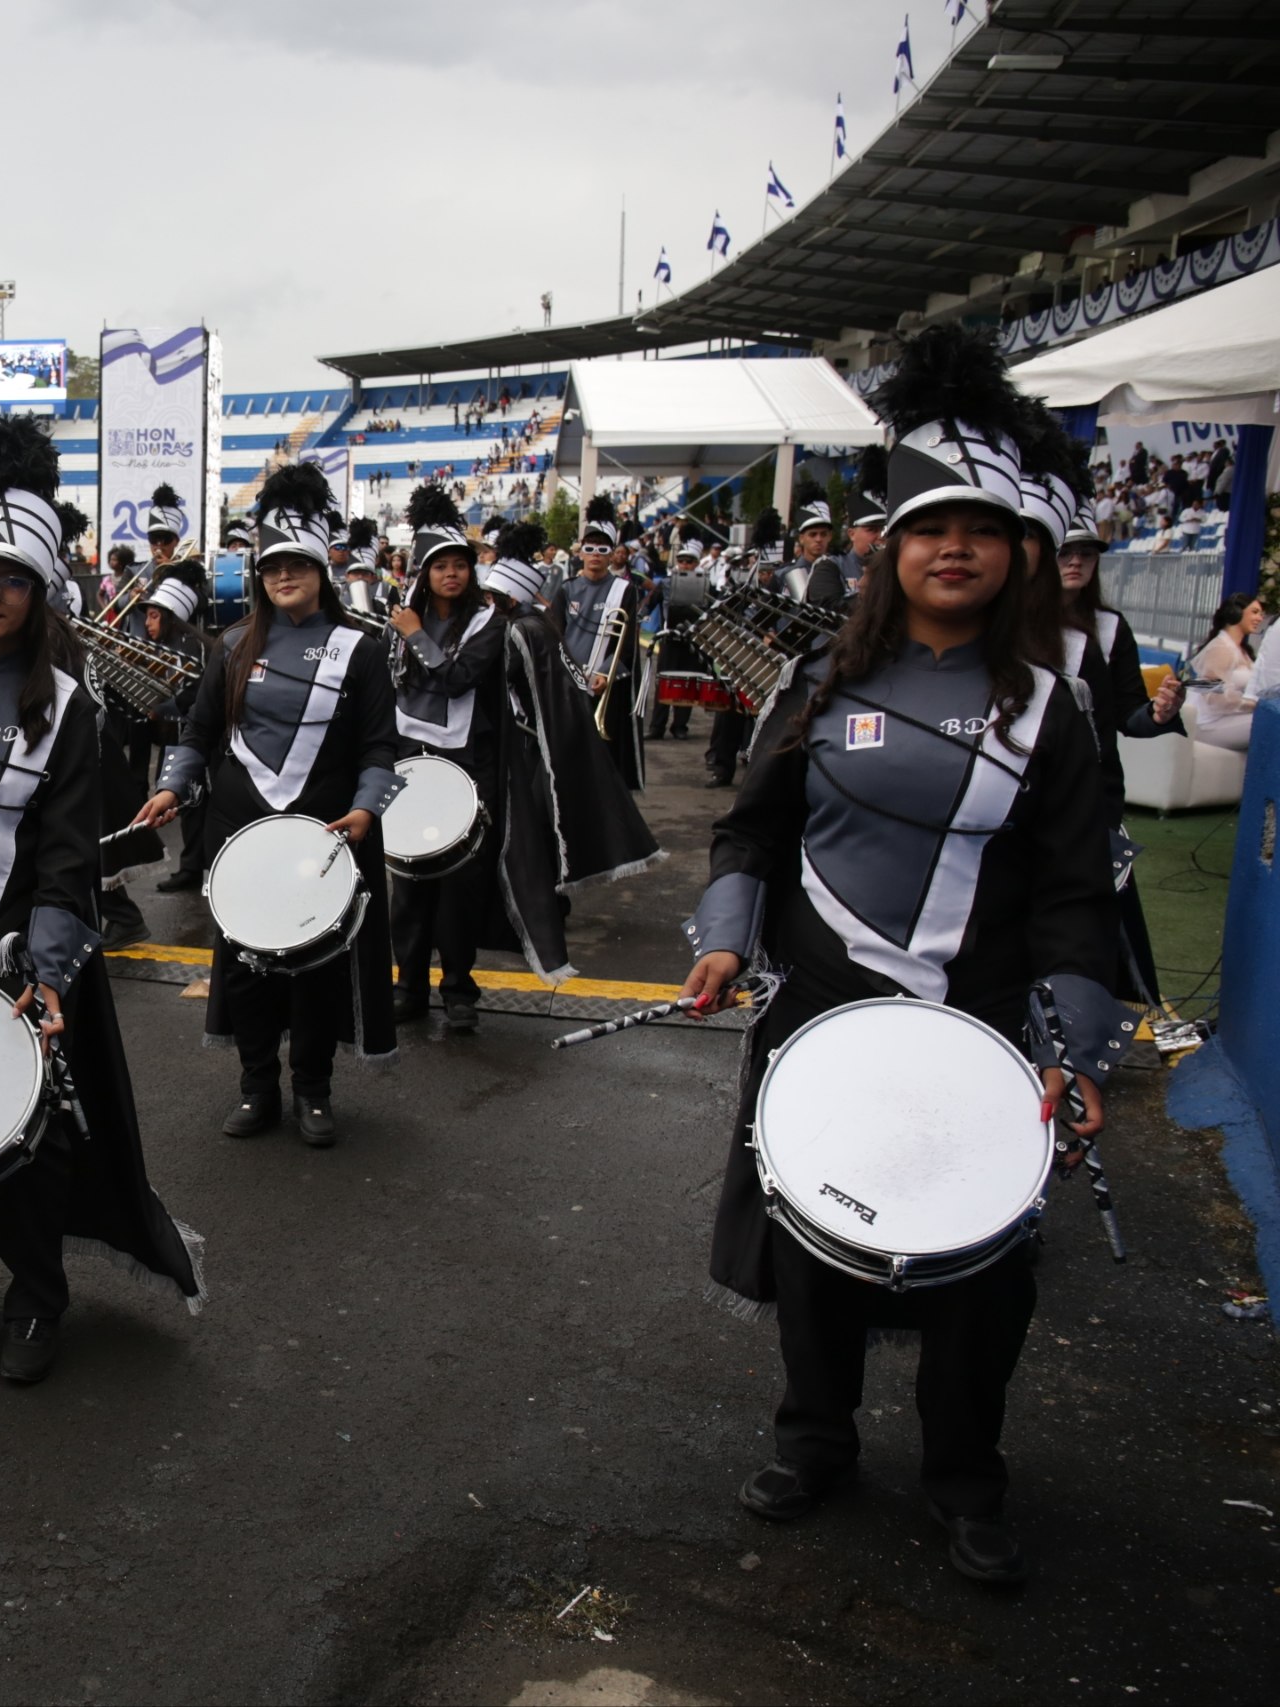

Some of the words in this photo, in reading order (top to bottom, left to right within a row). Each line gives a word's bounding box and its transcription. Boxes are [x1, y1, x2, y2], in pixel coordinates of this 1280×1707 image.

[136, 428, 175, 441] HON
[303, 646, 340, 661] BDG
[939, 717, 987, 736] BD
[819, 1183, 878, 1226] Parrot
